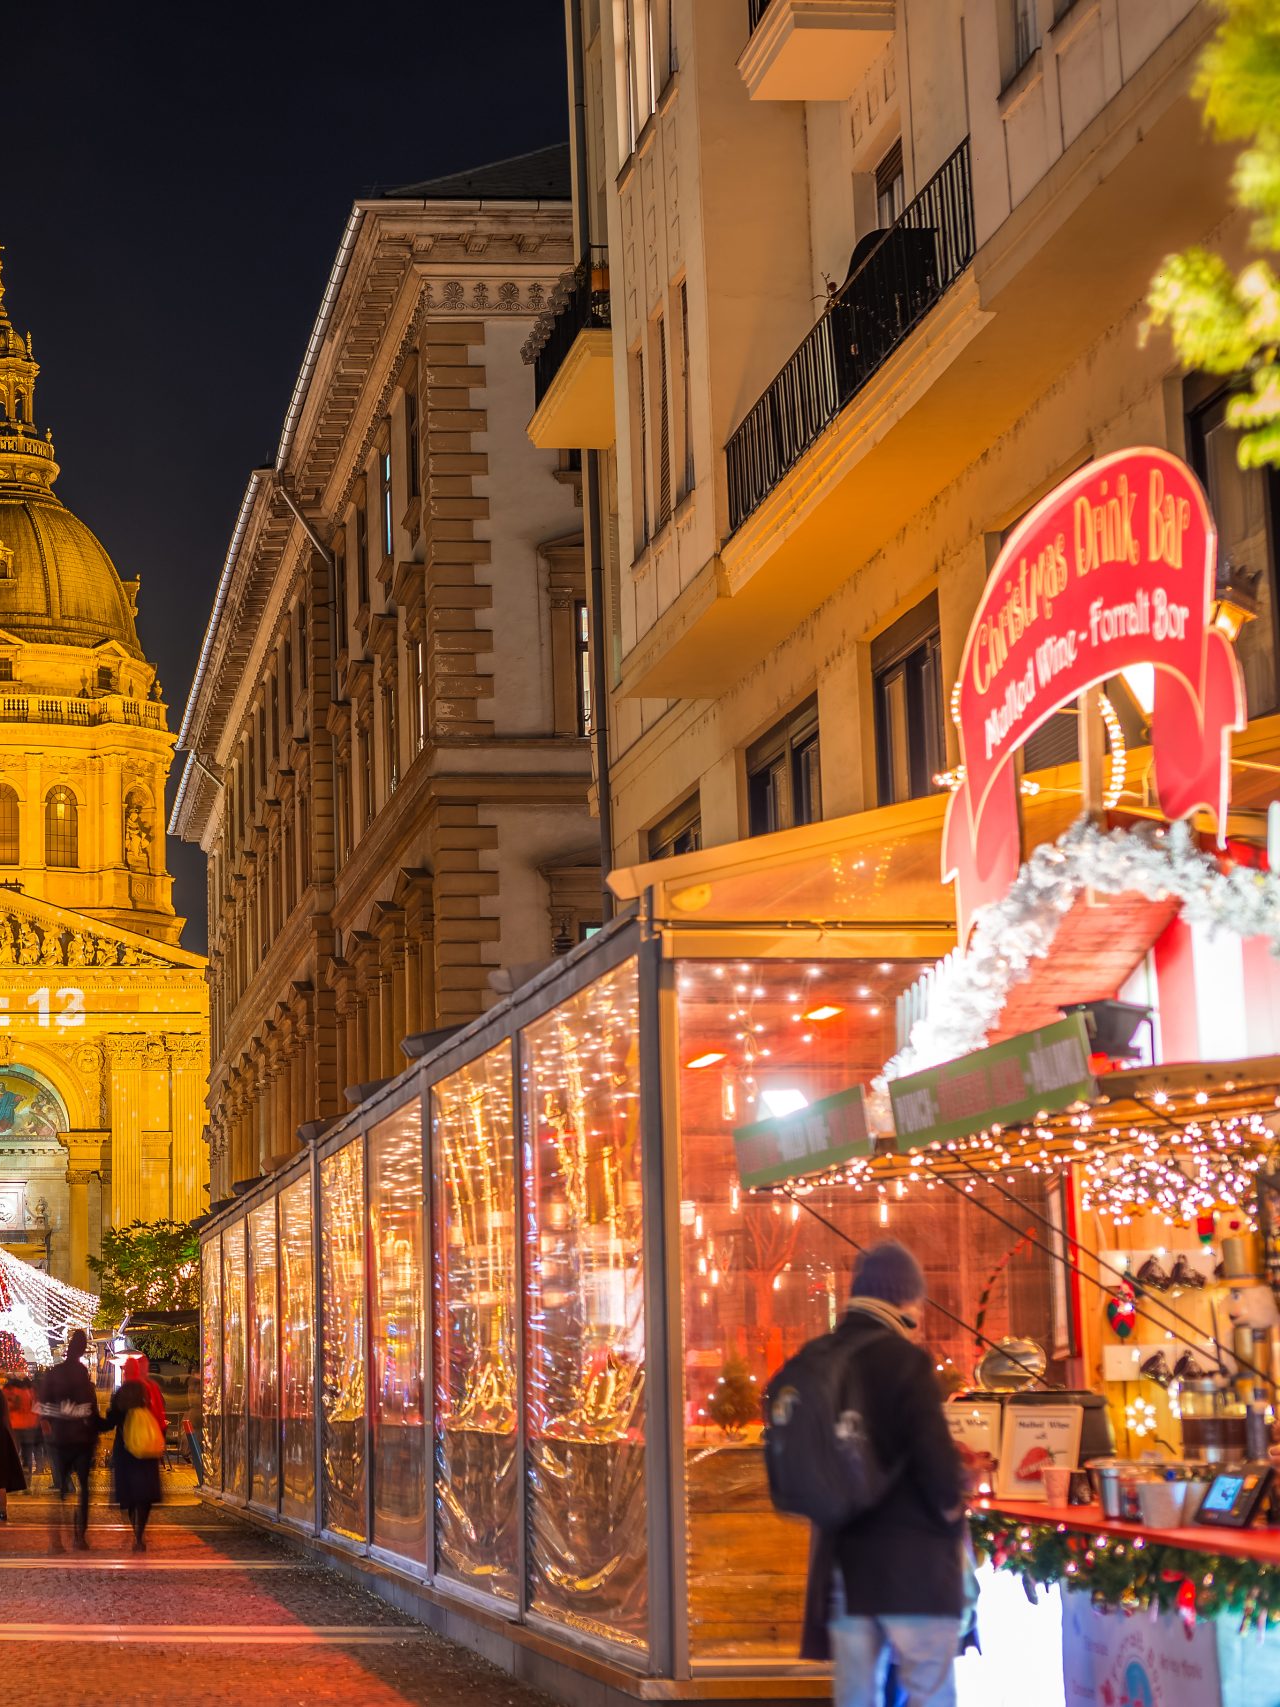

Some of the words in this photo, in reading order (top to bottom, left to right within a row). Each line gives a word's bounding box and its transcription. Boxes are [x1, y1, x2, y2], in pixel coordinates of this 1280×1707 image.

[973, 533, 1068, 695] Christmas
[1074, 473, 1140, 577] Drink
[1148, 469, 1191, 570] Bar
[1152, 587, 1190, 641] Bor
